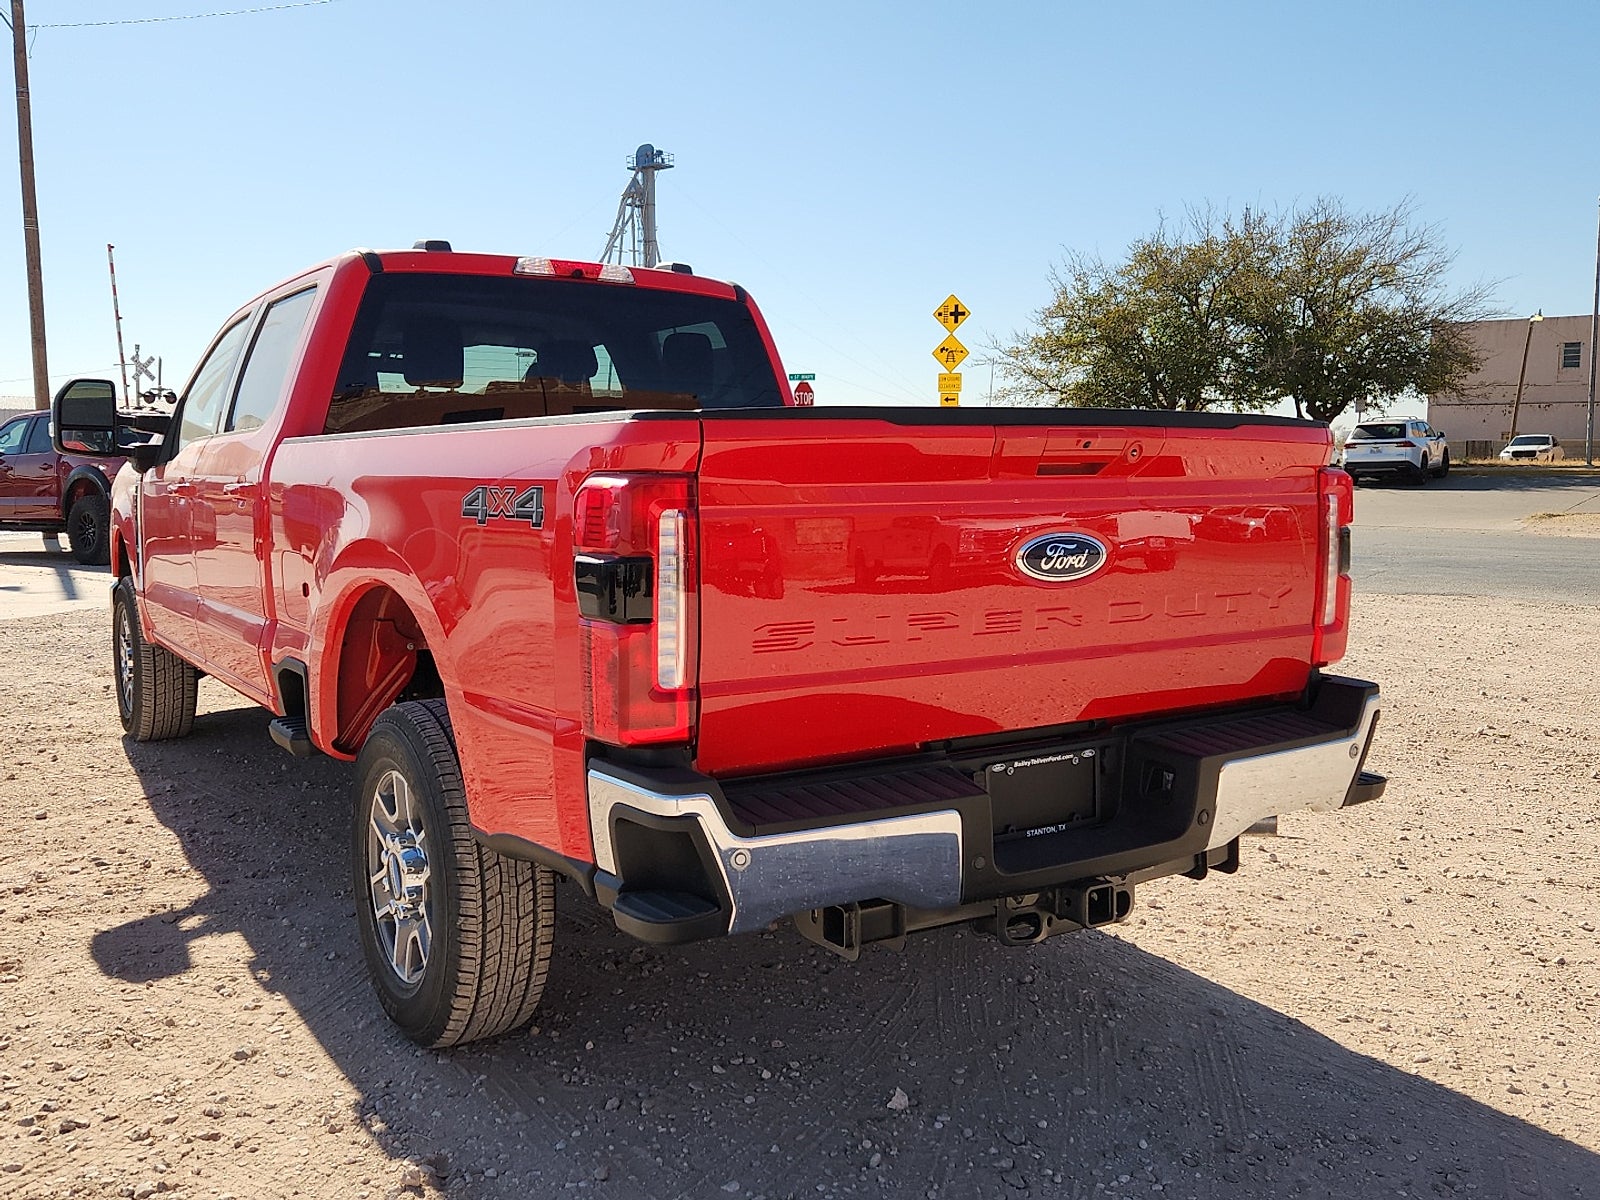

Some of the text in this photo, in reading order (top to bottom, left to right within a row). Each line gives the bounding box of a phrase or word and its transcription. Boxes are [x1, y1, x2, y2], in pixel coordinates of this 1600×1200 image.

[795, 391, 813, 405] STOP
[1040, 543, 1088, 571] Ford
[752, 588, 1293, 655] SUPER DUTY
